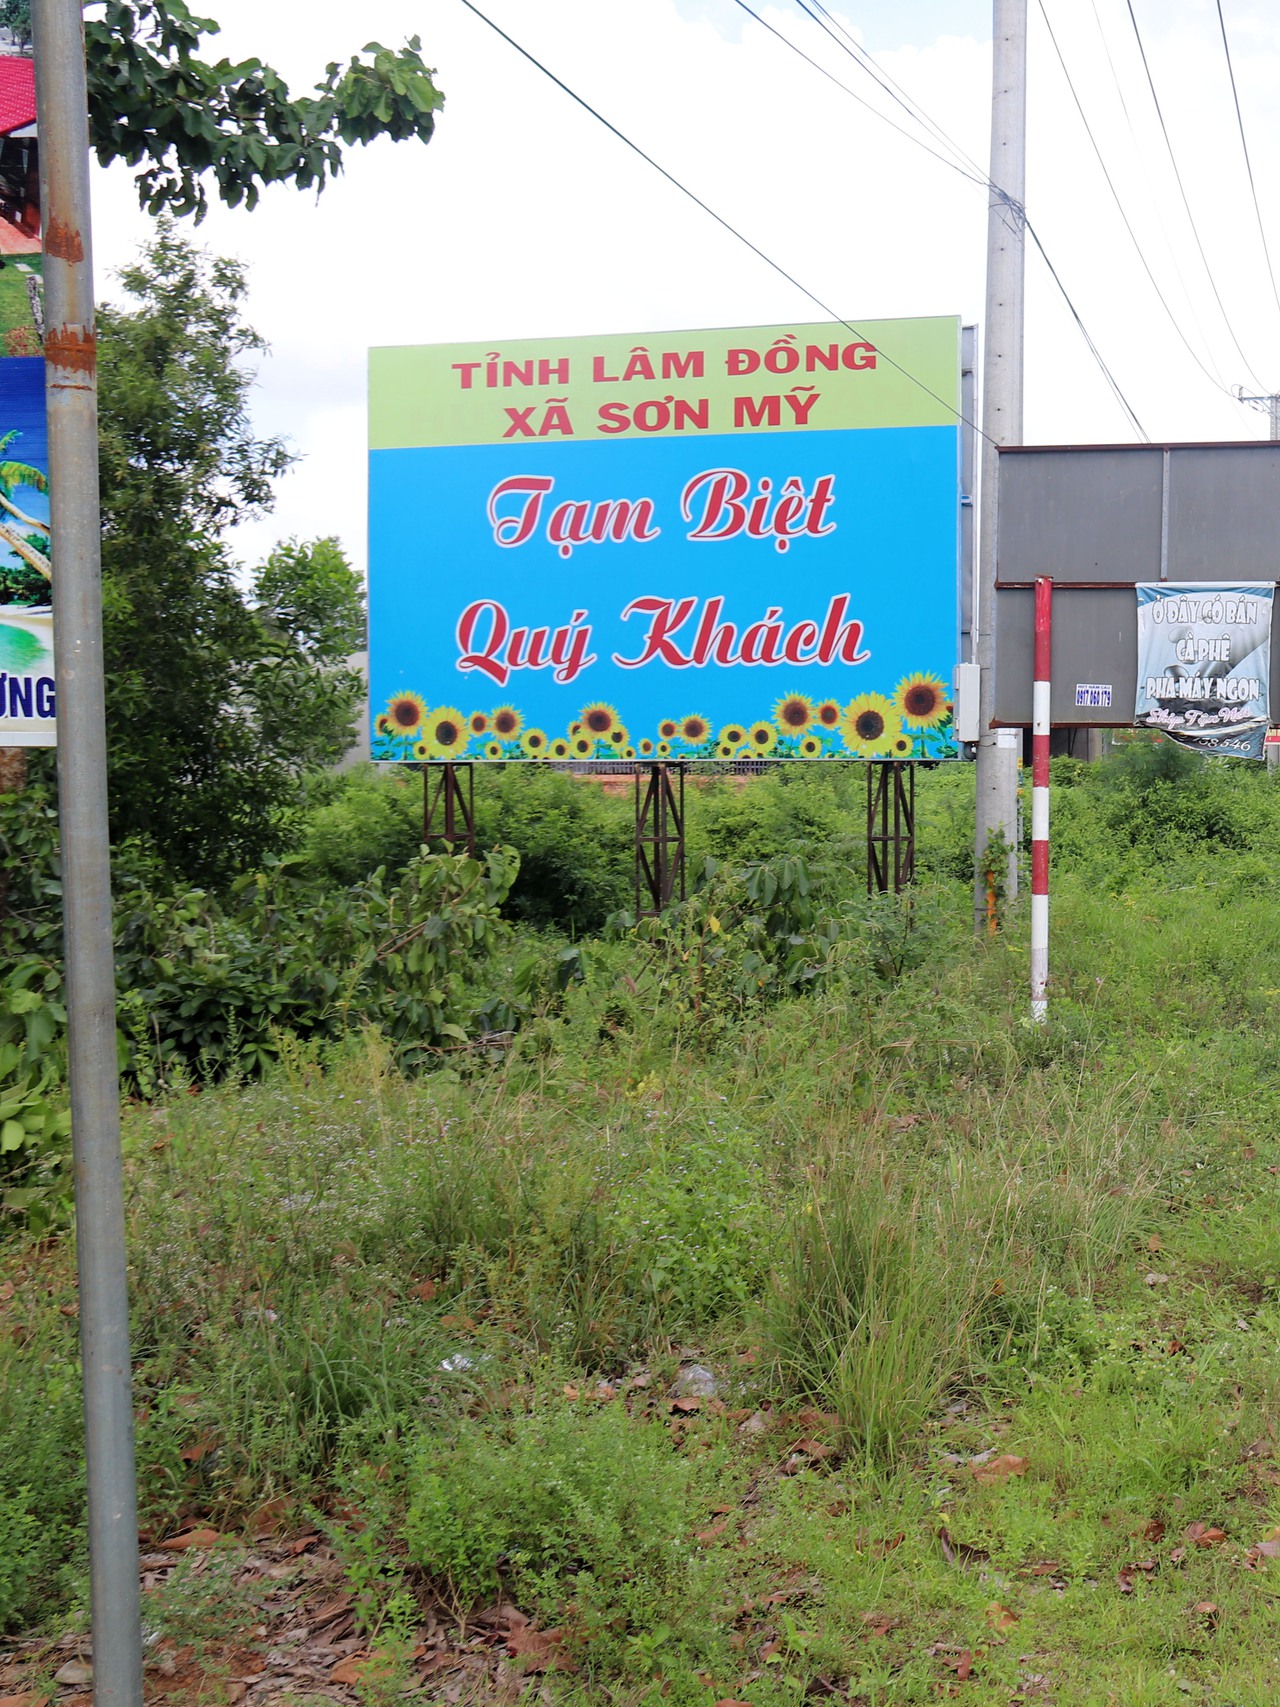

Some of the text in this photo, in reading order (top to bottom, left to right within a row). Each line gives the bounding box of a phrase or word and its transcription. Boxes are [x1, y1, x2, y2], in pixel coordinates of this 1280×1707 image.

[451, 334, 878, 389] TỈNH LÂM ĐỒNG
[502, 385, 821, 438] XÃ SƠN MỸ
[487, 467, 836, 558] Tạm Biệt
[1166, 595, 1200, 624] ĐÂY
[1202, 594, 1224, 624] CÓ
[1225, 595, 1258, 624] BÁN
[455, 593, 871, 687] Quý Khách
[1176, 632, 1231, 662] CÀ PHÊ
[1146, 672, 1260, 701] PHA MÁY NGON
